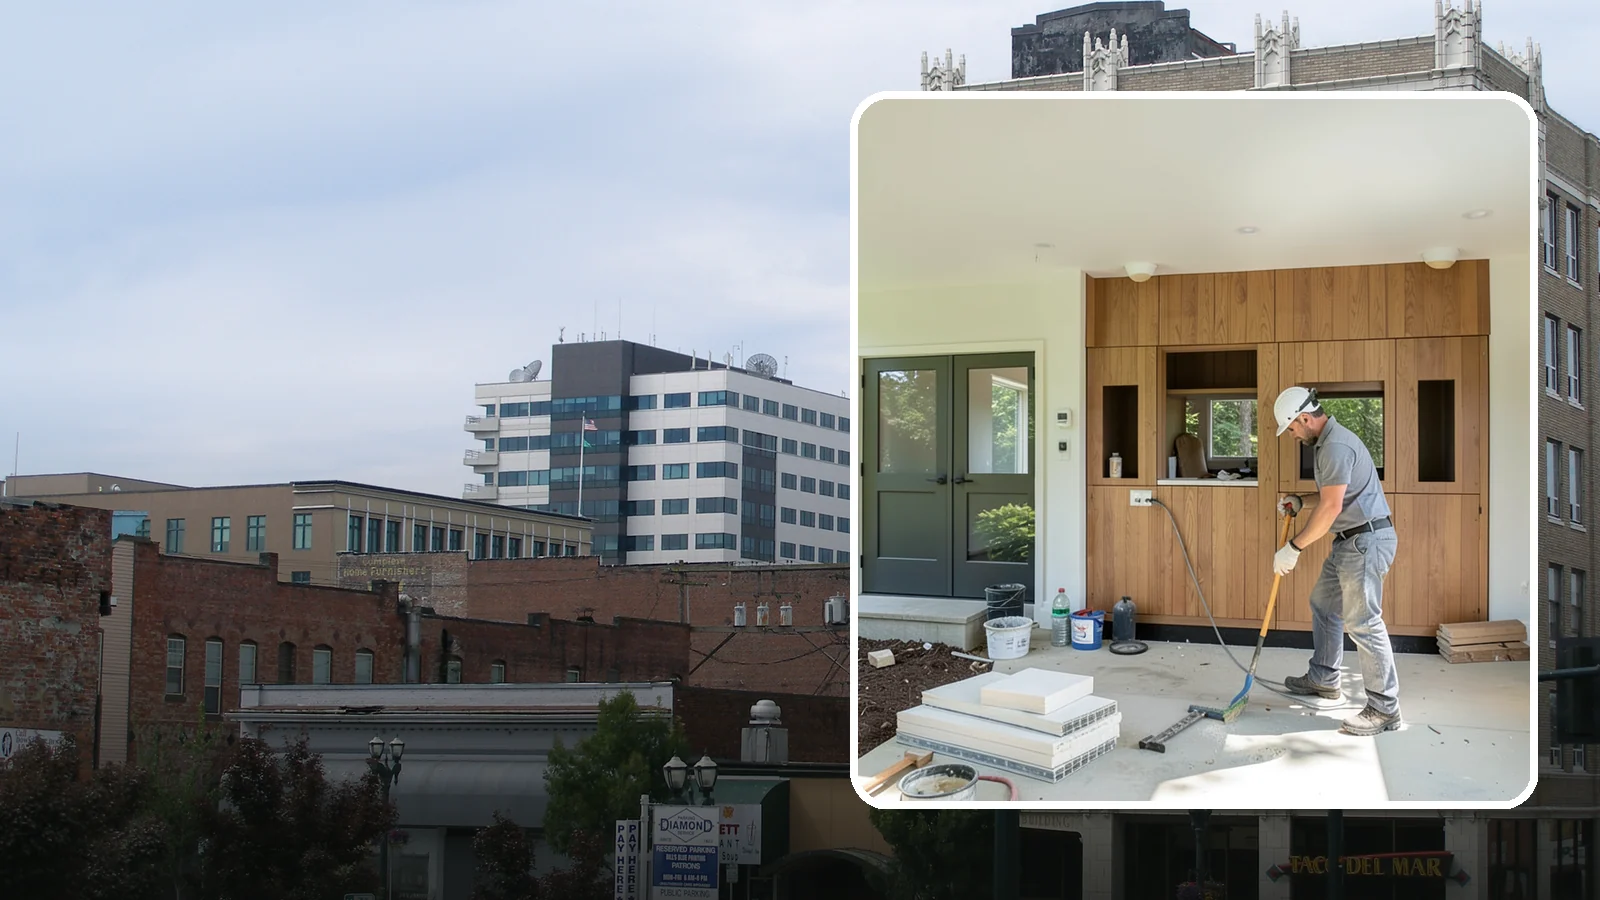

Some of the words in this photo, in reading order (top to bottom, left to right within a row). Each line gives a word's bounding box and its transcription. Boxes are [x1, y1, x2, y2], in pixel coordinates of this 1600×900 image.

[370, 566, 427, 577] Furnishers
[660, 818, 713, 833] DIAMOND
[1021, 815, 1071, 828] BUILDING
[617, 825, 625, 852] PAY
[628, 825, 636, 852] PAY
[655, 845, 688, 853] RESERVED
[689, 846, 716, 854] PARKING
[721, 851, 739, 862] Soup
[671, 862, 701, 870] PATRONS
[1346, 856, 1384, 875] DEL
[1392, 857, 1442, 877] MAR
[616, 856, 625, 893] HERE
[627, 856, 636, 893] HERE
[660, 889, 682, 897] PUBLIC
[683, 889, 711, 898] PARKING
